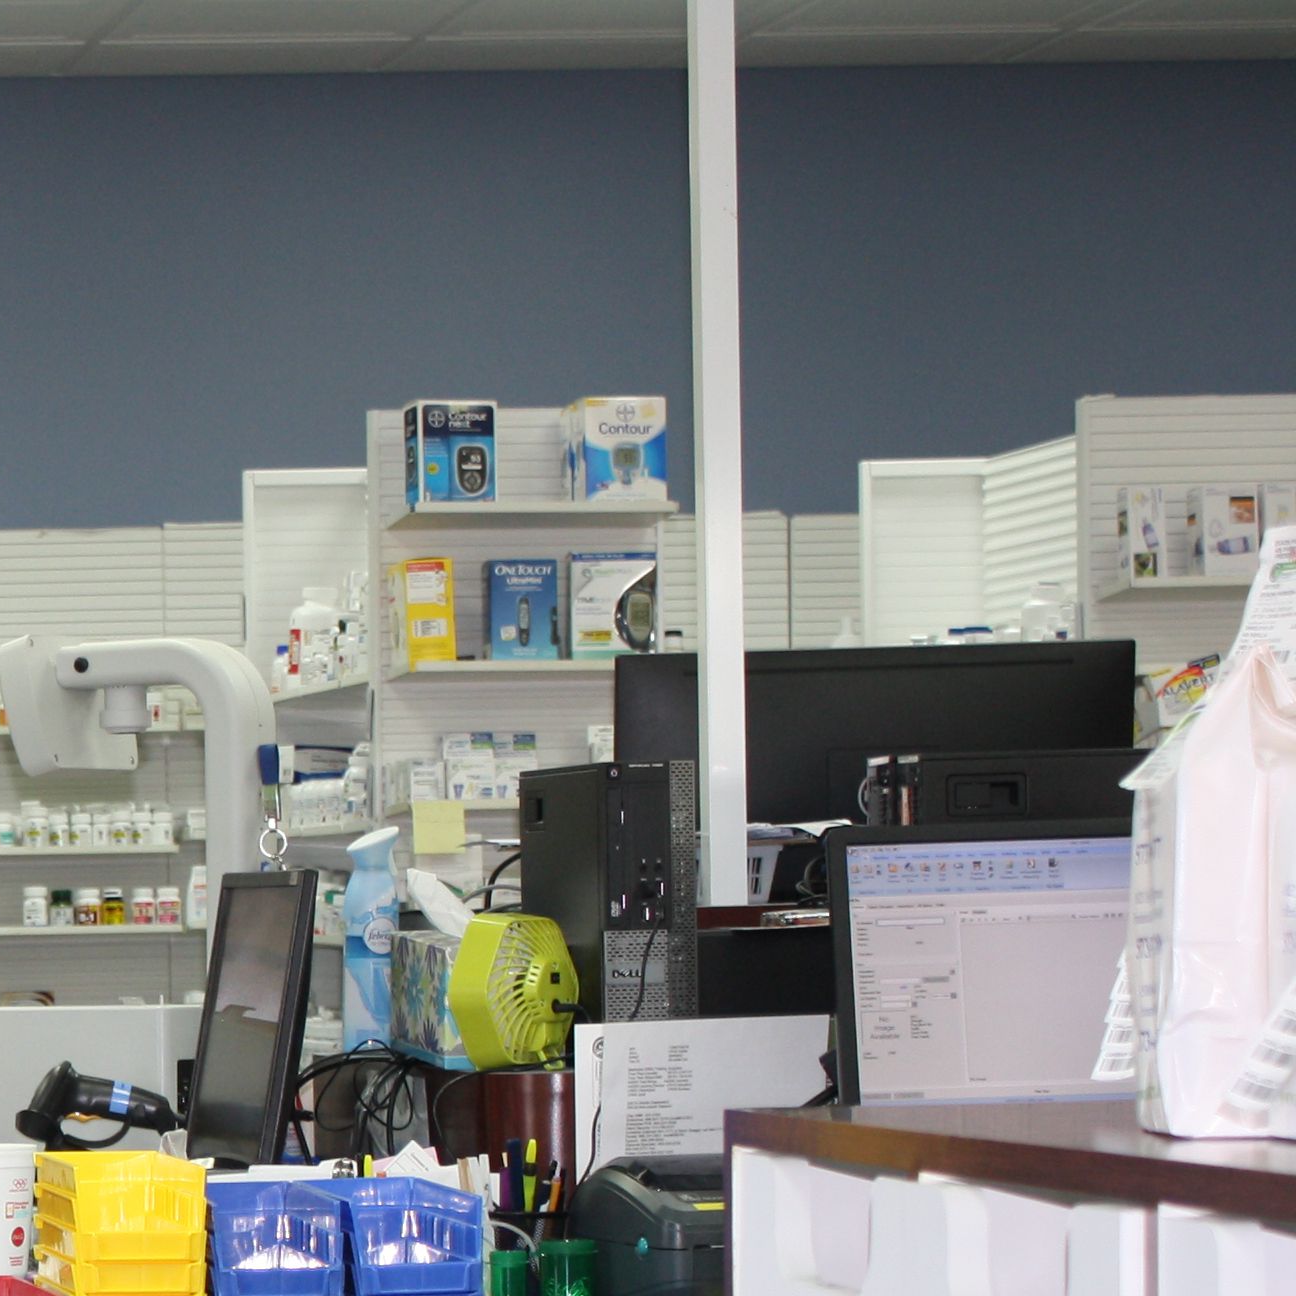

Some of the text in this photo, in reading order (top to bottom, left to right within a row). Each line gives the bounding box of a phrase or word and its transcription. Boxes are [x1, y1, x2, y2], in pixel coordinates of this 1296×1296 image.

[448, 412, 487, 422] Contour
[599, 422, 653, 435] Contour
[612, 969, 642, 978] DELL
